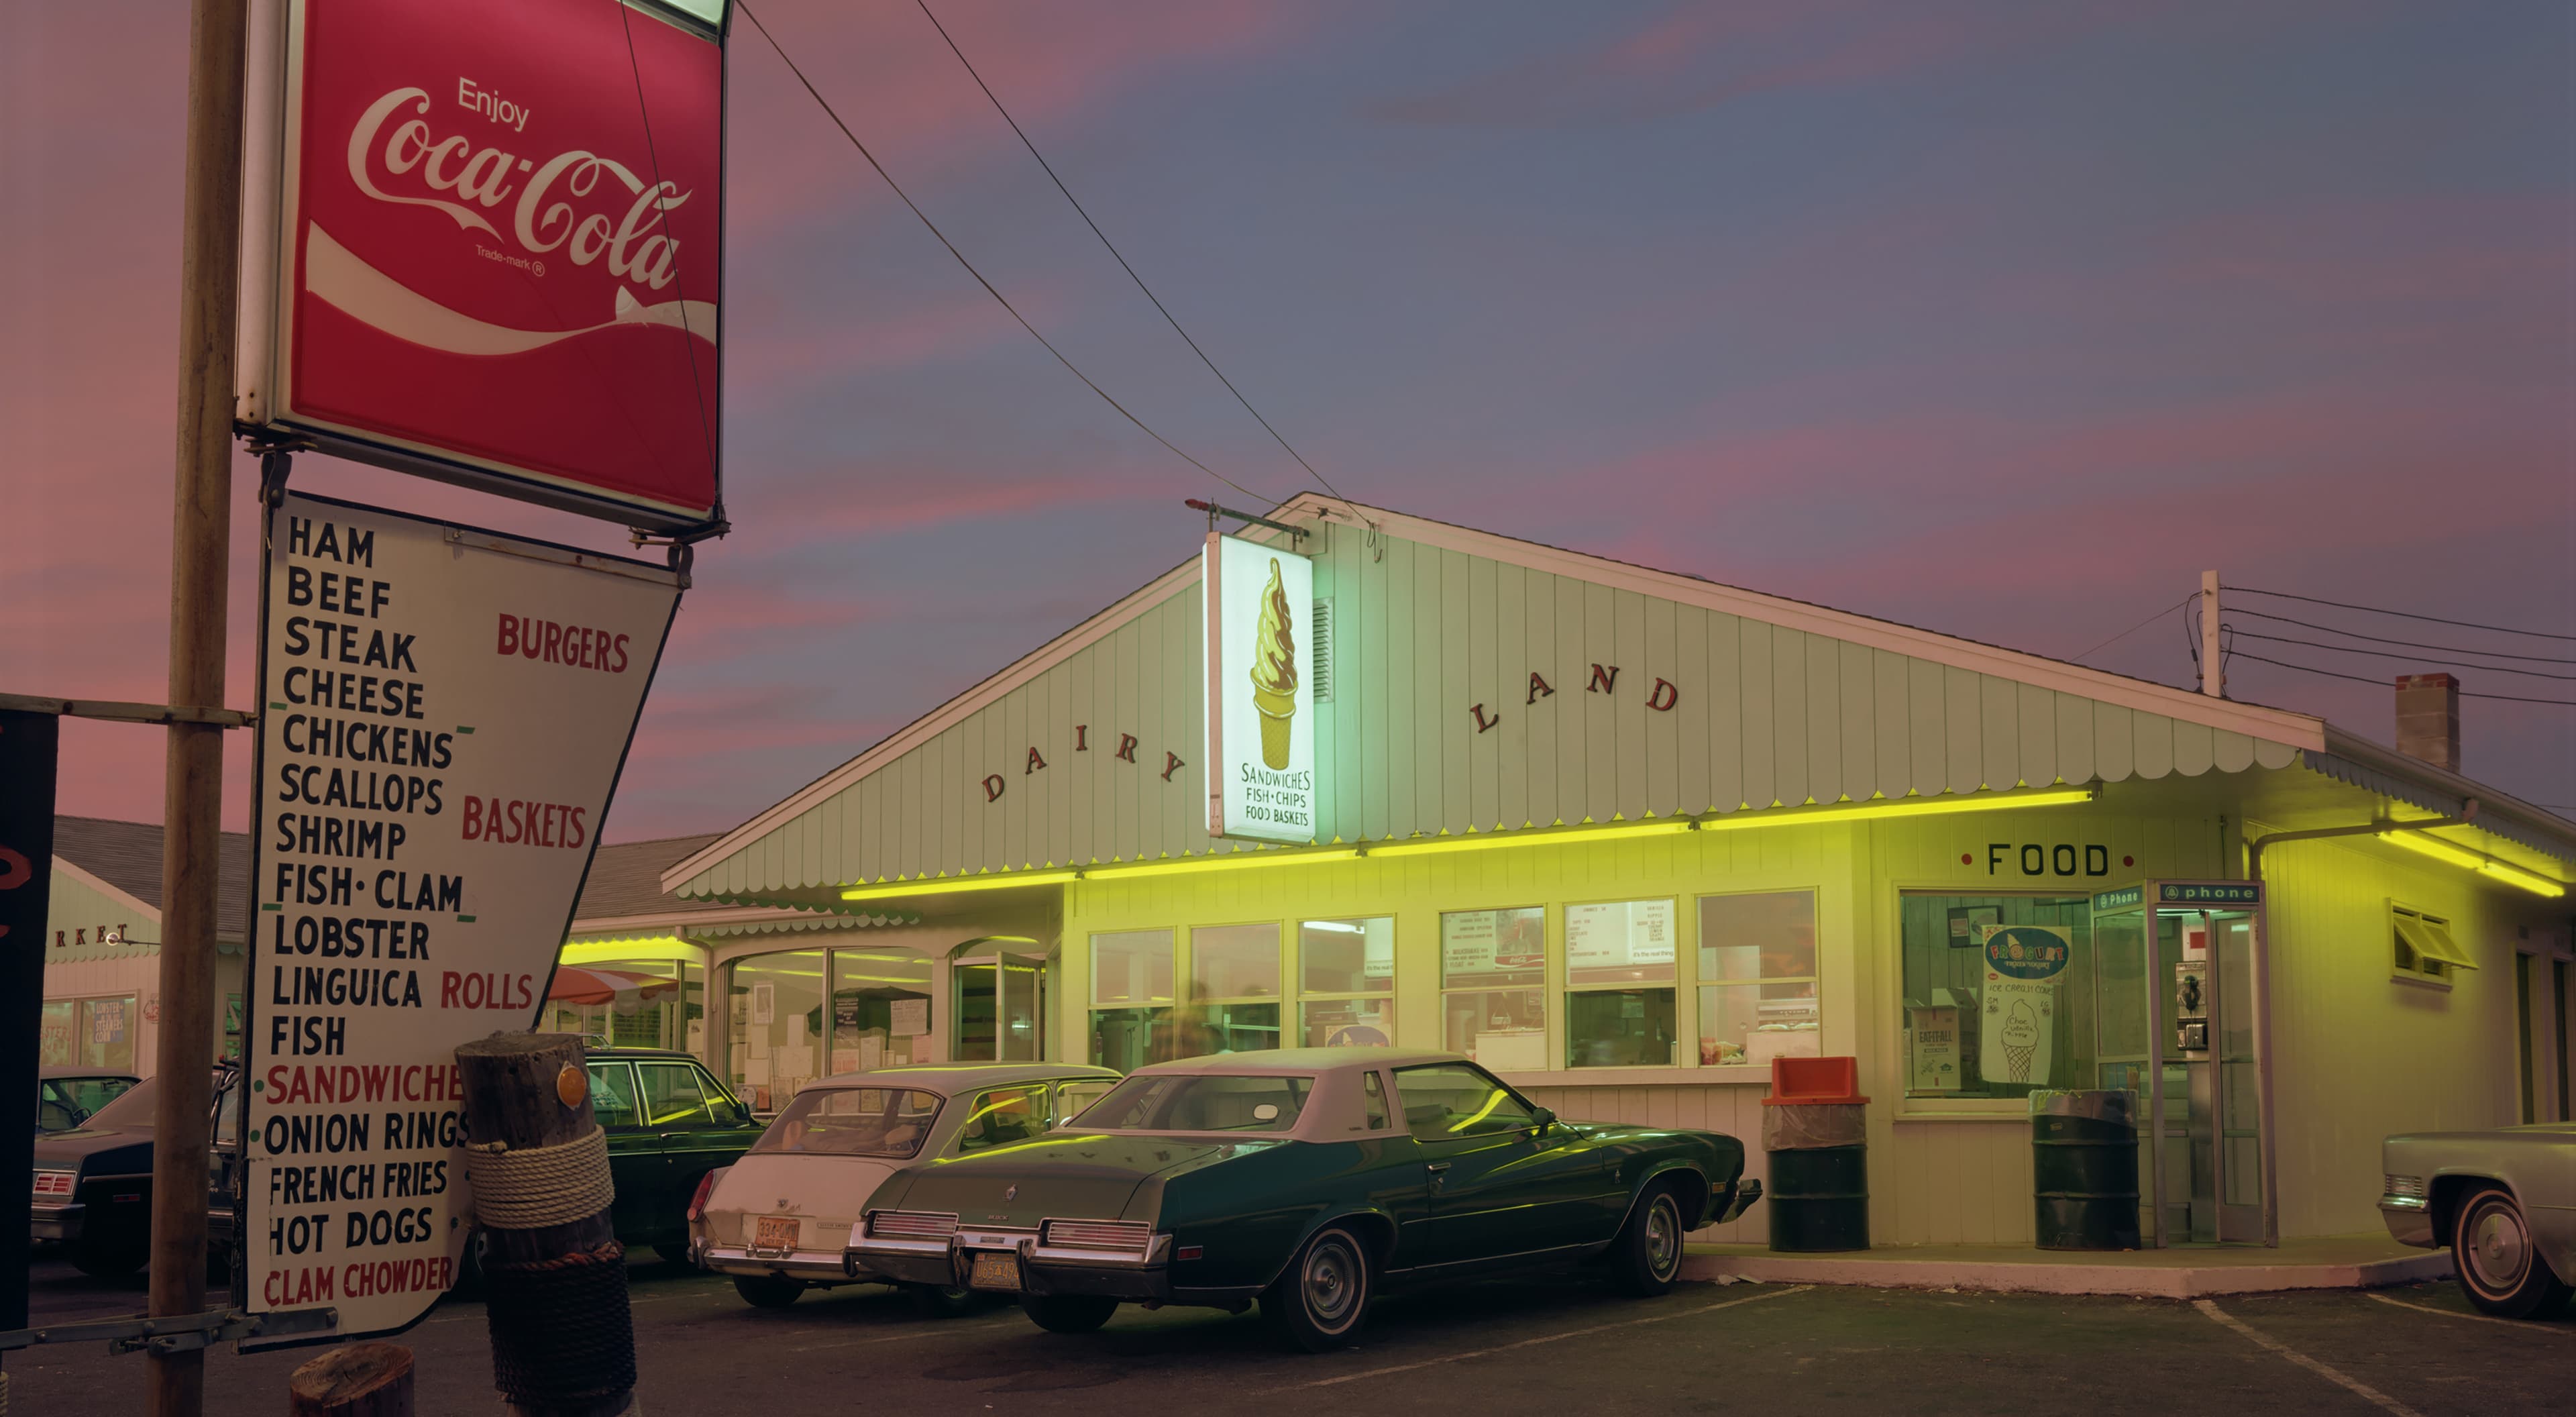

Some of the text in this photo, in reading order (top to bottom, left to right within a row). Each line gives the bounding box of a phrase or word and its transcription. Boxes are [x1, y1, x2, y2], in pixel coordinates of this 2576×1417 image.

[459, 77, 529, 132] Enjoy
[476, 244, 531, 270] Trade-mark
[289, 517, 374, 568] HAM
[288, 566, 390, 619] BEEF
[284, 617, 417, 673] STEAK
[498, 613, 629, 673] BURGERS
[283, 666, 424, 719] CHEESE
[283, 714, 453, 769] CHICKENS
[982, 663, 1678, 802] DAIRY LAND
[279, 763, 443, 815] SCALLOPS
[1241, 763, 1310, 791] SANDWICHES
[276, 812, 406, 860] SHRIMP
[462, 796, 586, 849] BASKETS
[1246, 805, 1309, 826] FOOD BASKETS
[1989, 844, 2108, 877] FOOD
[375, 870, 462, 912] CLAM
[2110, 891, 2138, 905] Phone
[2186, 887, 2254, 901] phone
[56, 924, 127, 947] RKET
[275, 916, 430, 960] LOBSTER
[1990, 943, 2064, 961] FROGURT
[273, 966, 533, 1010] LINGUICA ROLLS
[270, 1016, 346, 1055] FISH
[266, 1064, 464, 1104] SANDWICHE
[266, 1110, 469, 1155] ONION RINGS
[270, 1160, 447, 1205] FRENCH FRIES
[270, 1208, 432, 1256] HOT DOGS
[264, 1257, 453, 1306] CLAM CHOWDER
